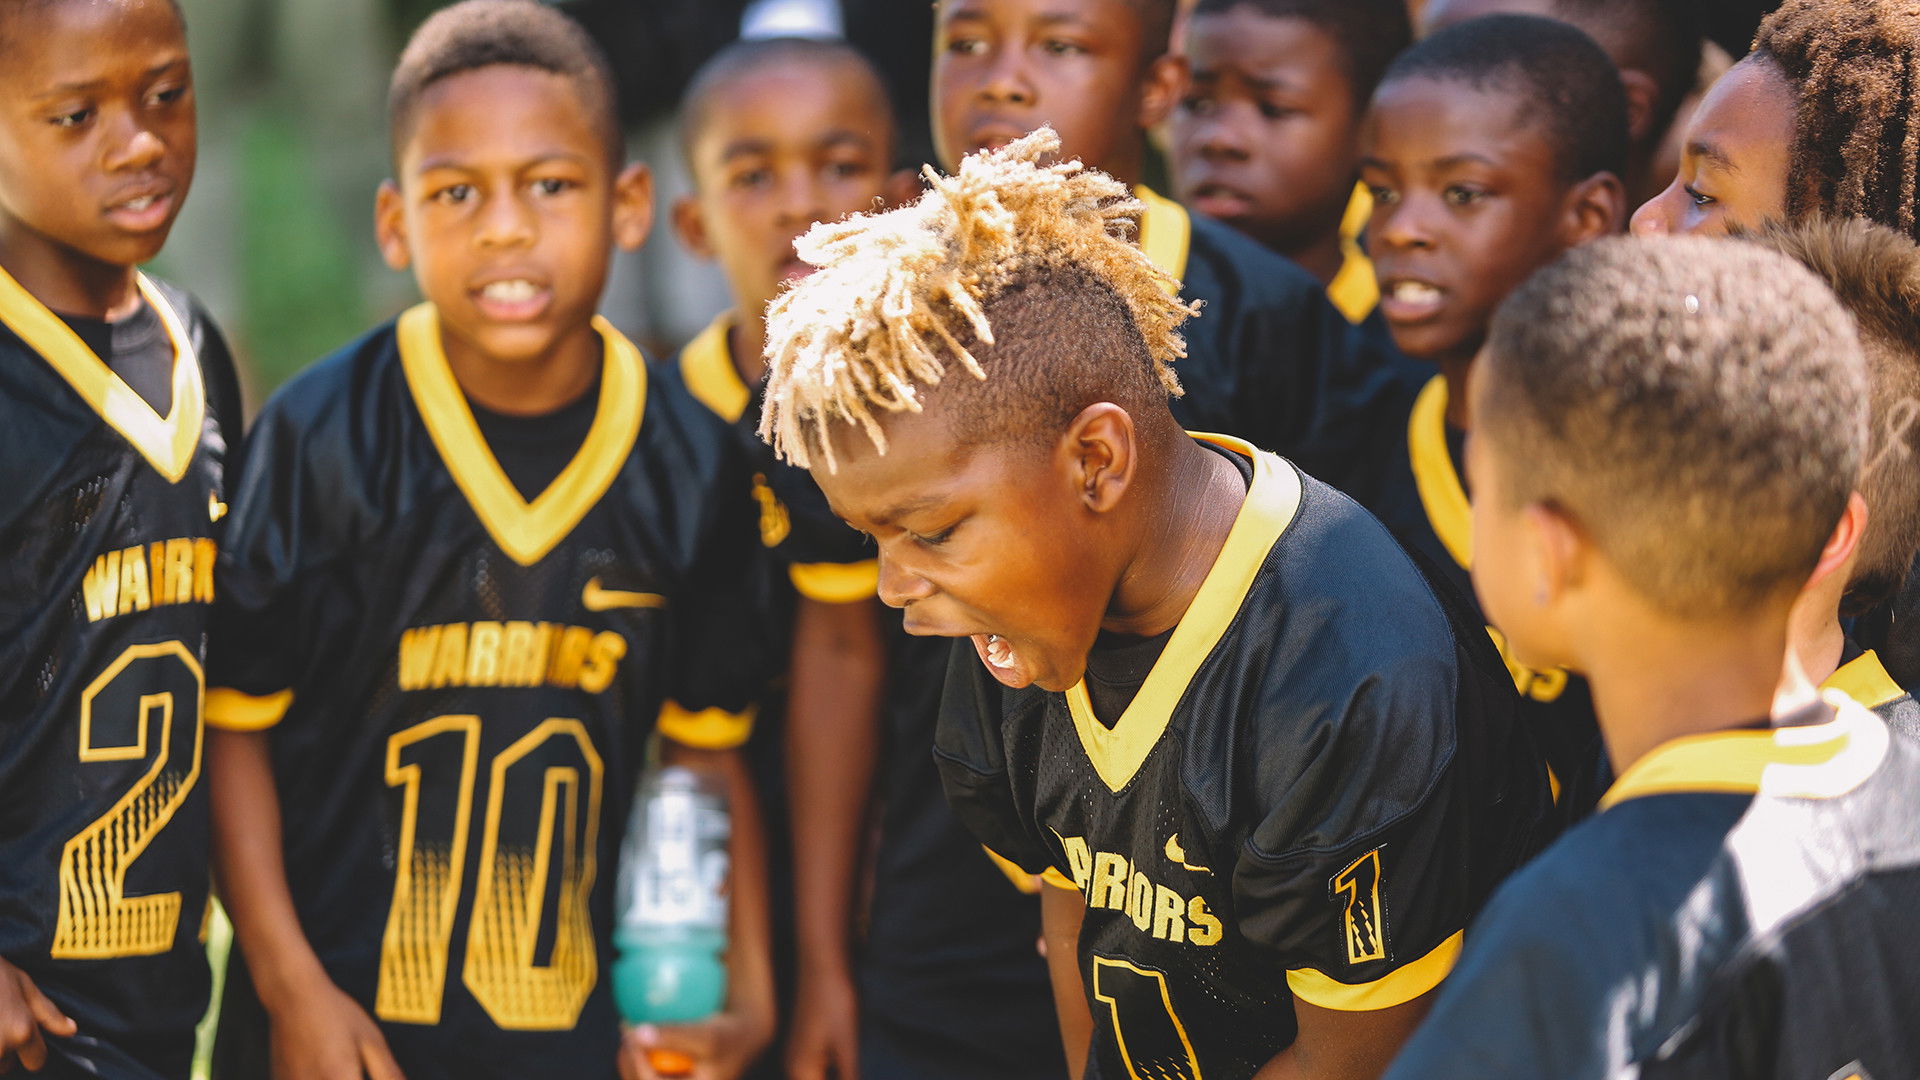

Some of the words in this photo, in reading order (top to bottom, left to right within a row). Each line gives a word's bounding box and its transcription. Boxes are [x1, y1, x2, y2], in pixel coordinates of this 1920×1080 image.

[51, 640, 205, 960] 2
[374, 714, 604, 1031] 10
[1335, 849, 1385, 964] 1
[1094, 955, 1203, 1080] 1
